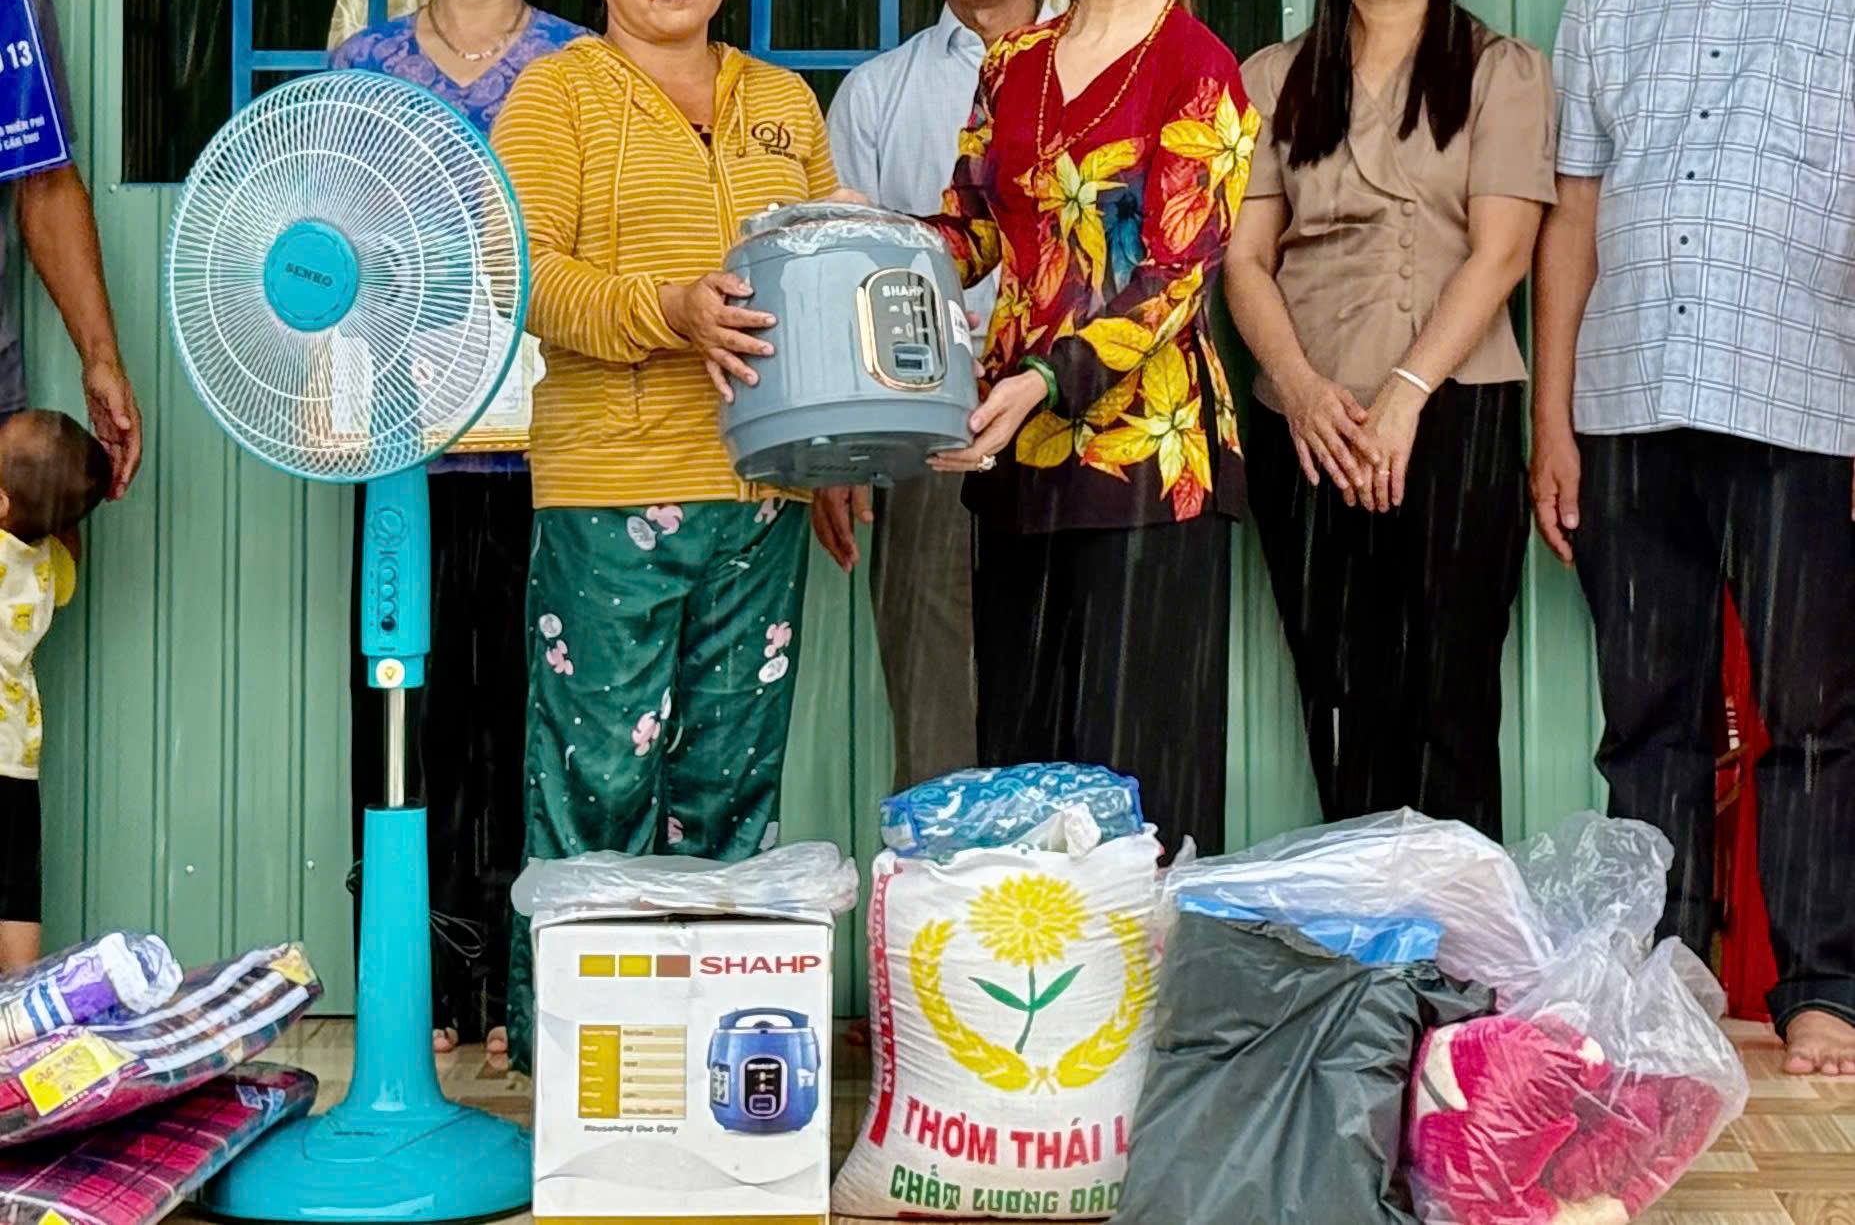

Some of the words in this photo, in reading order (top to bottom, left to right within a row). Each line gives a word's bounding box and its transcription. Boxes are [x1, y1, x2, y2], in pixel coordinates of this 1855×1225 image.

[6, 40, 33, 69] 13
[699, 955, 821, 974] SHAHP
[902, 1095, 998, 1165] THƠM
[1010, 1116, 1101, 1170] THÁI
